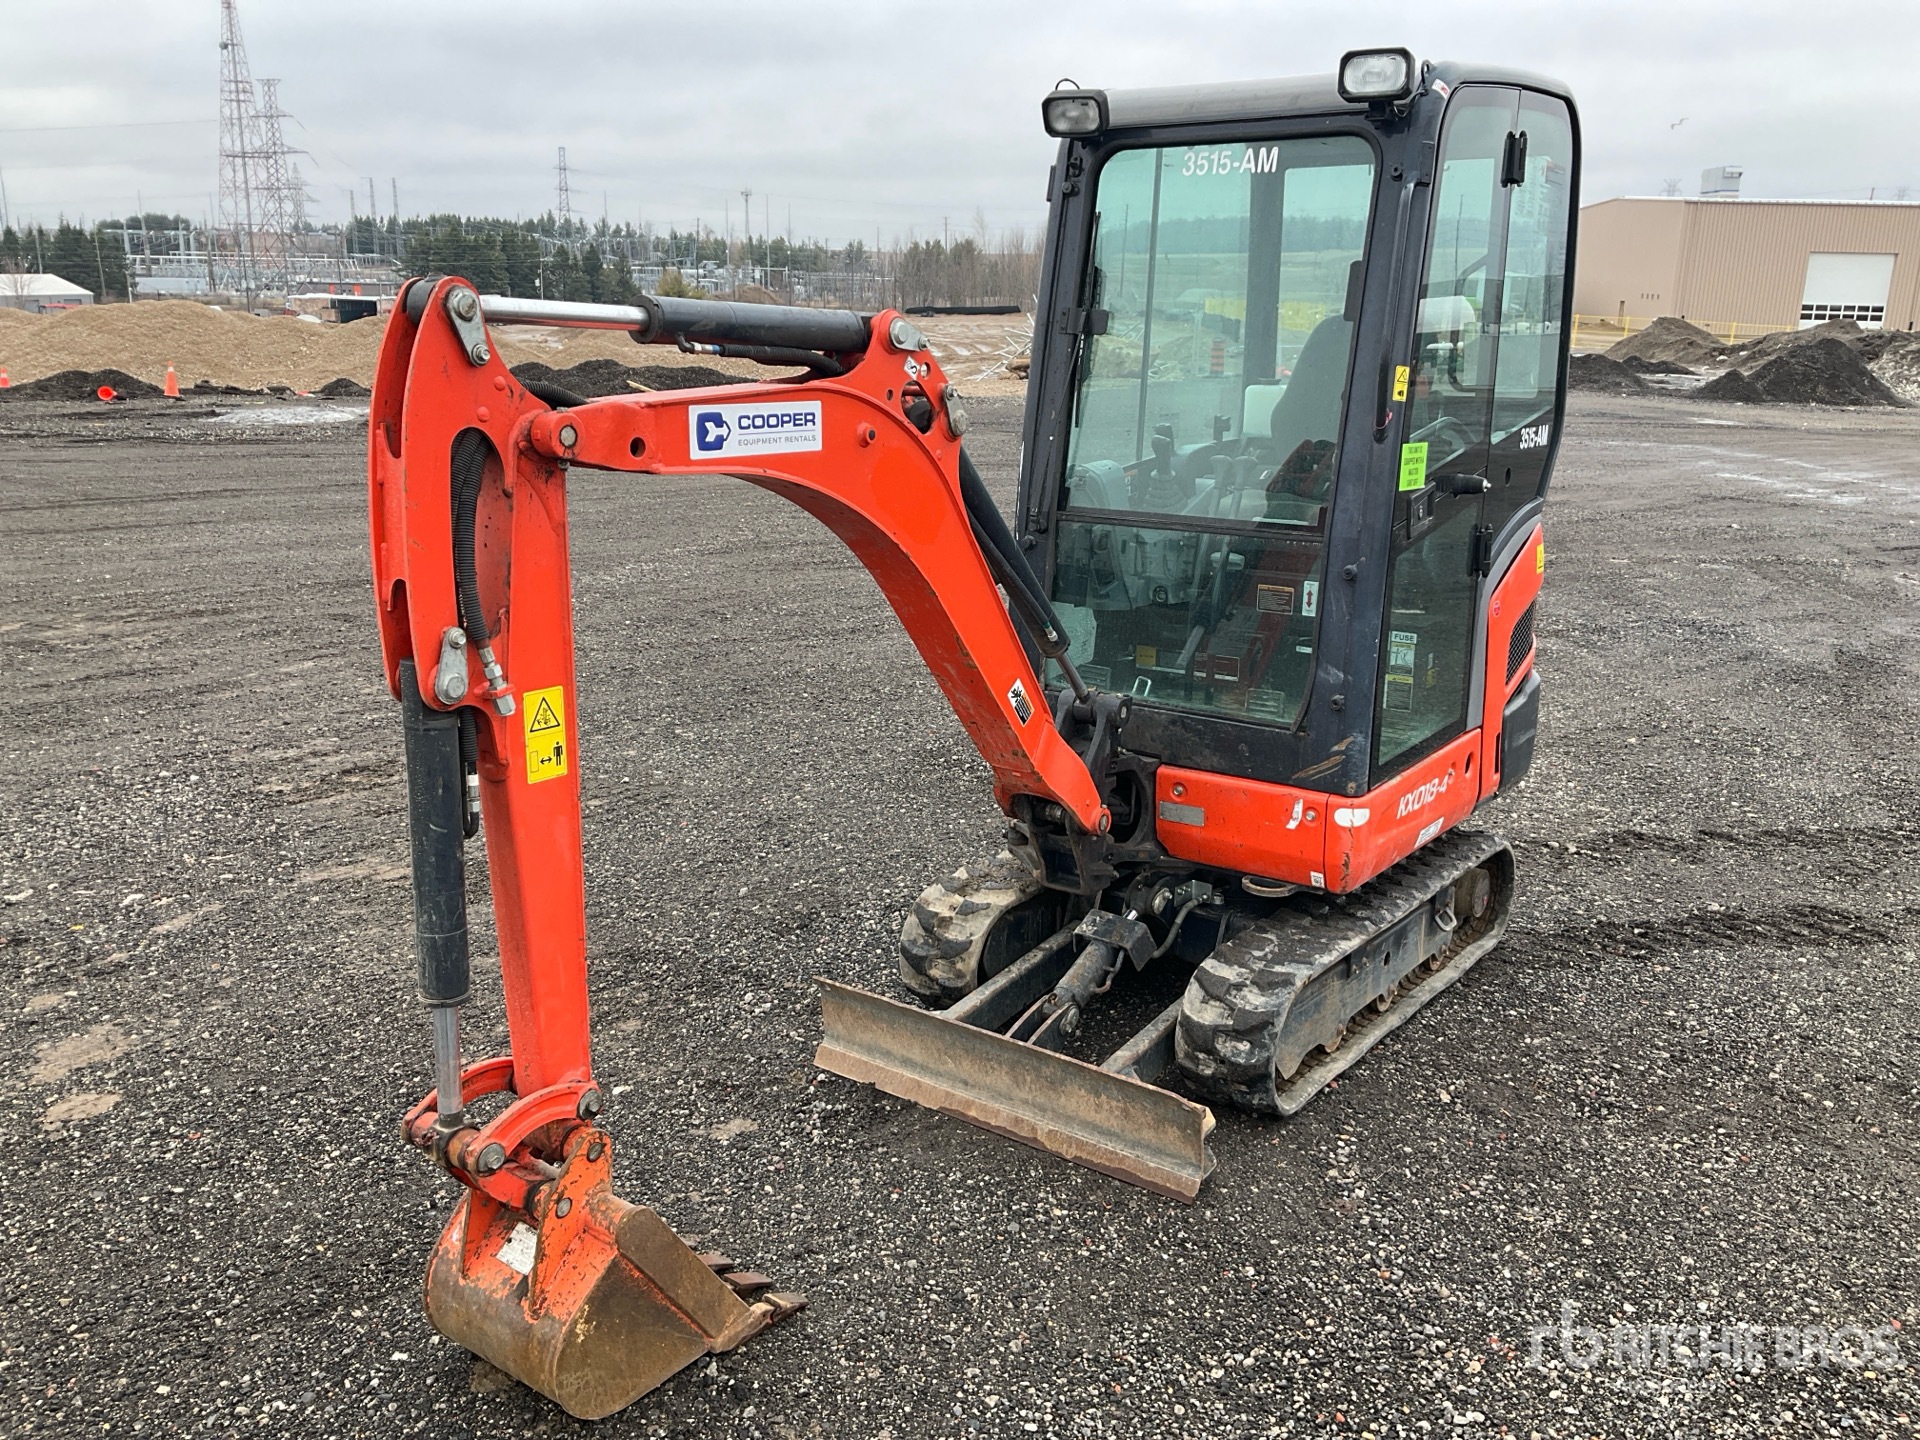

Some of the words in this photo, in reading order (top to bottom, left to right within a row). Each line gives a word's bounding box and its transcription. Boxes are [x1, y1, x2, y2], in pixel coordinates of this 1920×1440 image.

[1182, 146, 1279, 176] 3515-AM
[737, 412, 816, 430] COOPER
[737, 436, 782, 446] EQUIPMENT
[784, 434, 817, 444] RENTALS
[1519, 424, 1549, 449] 3515-AM
[1394, 633, 1415, 642] FUSE
[1396, 774, 1449, 820] KX018-4
